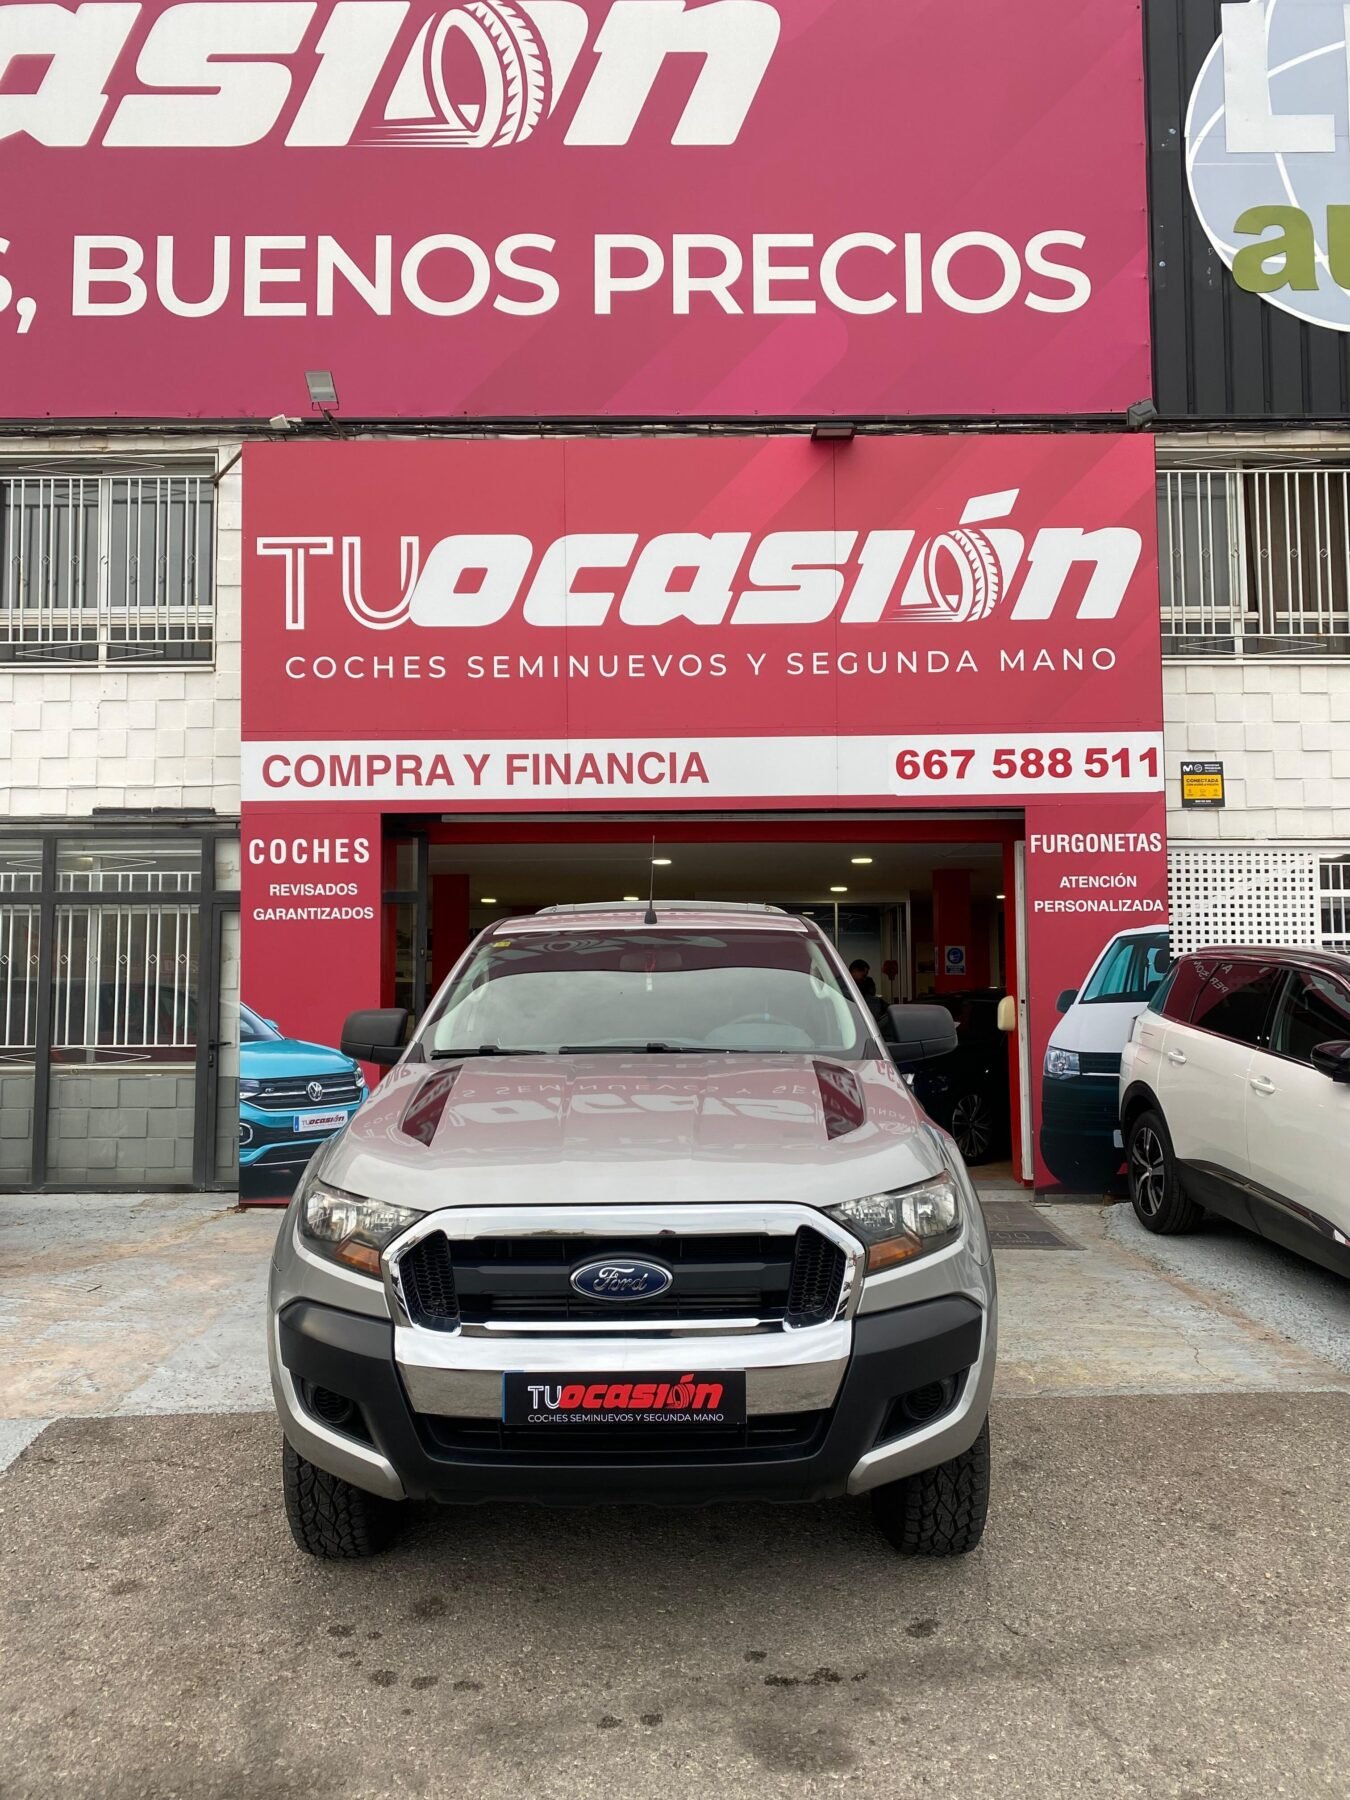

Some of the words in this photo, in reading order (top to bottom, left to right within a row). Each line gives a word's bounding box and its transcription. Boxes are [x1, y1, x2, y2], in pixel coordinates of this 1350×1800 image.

[72, 233, 560, 318] BUENOS
[594, 229, 1092, 315] PRECIOS
[285, 655, 446, 679] COCHES
[467, 653, 727, 679] SEMINUEVOS
[746, 653, 766, 676] Y
[787, 649, 979, 675] SEGUNDA
[1000, 647, 1116, 672] MANO
[262, 754, 455, 788] COMPRA
[463, 753, 491, 786] Y
[506, 751, 710, 786] FINANCIA
[895, 749, 976, 780] 667
[992, 748, 1073, 779] 588
[1084, 747, 1158, 779] 511
[249, 838, 370, 865] COCHES
[1030, 832, 1162, 854] FURGONETAS
[269, 882, 358, 897] REVISADOS
[1059, 872, 1137, 888] ATENCIÓN
[253, 906, 374, 921] GARANTIZADOS
[1034, 899, 1164, 913] PERSONALIZADA
[592, 1266, 649, 1292] Ford
[527, 1414, 569, 1423] COCHES
[570, 1413, 634, 1423] SEMINUEVOS
[635, 1413, 642, 1422] Y
[643, 1413, 692, 1422] SEGUNDA
[693, 1412, 724, 1422] MANO
